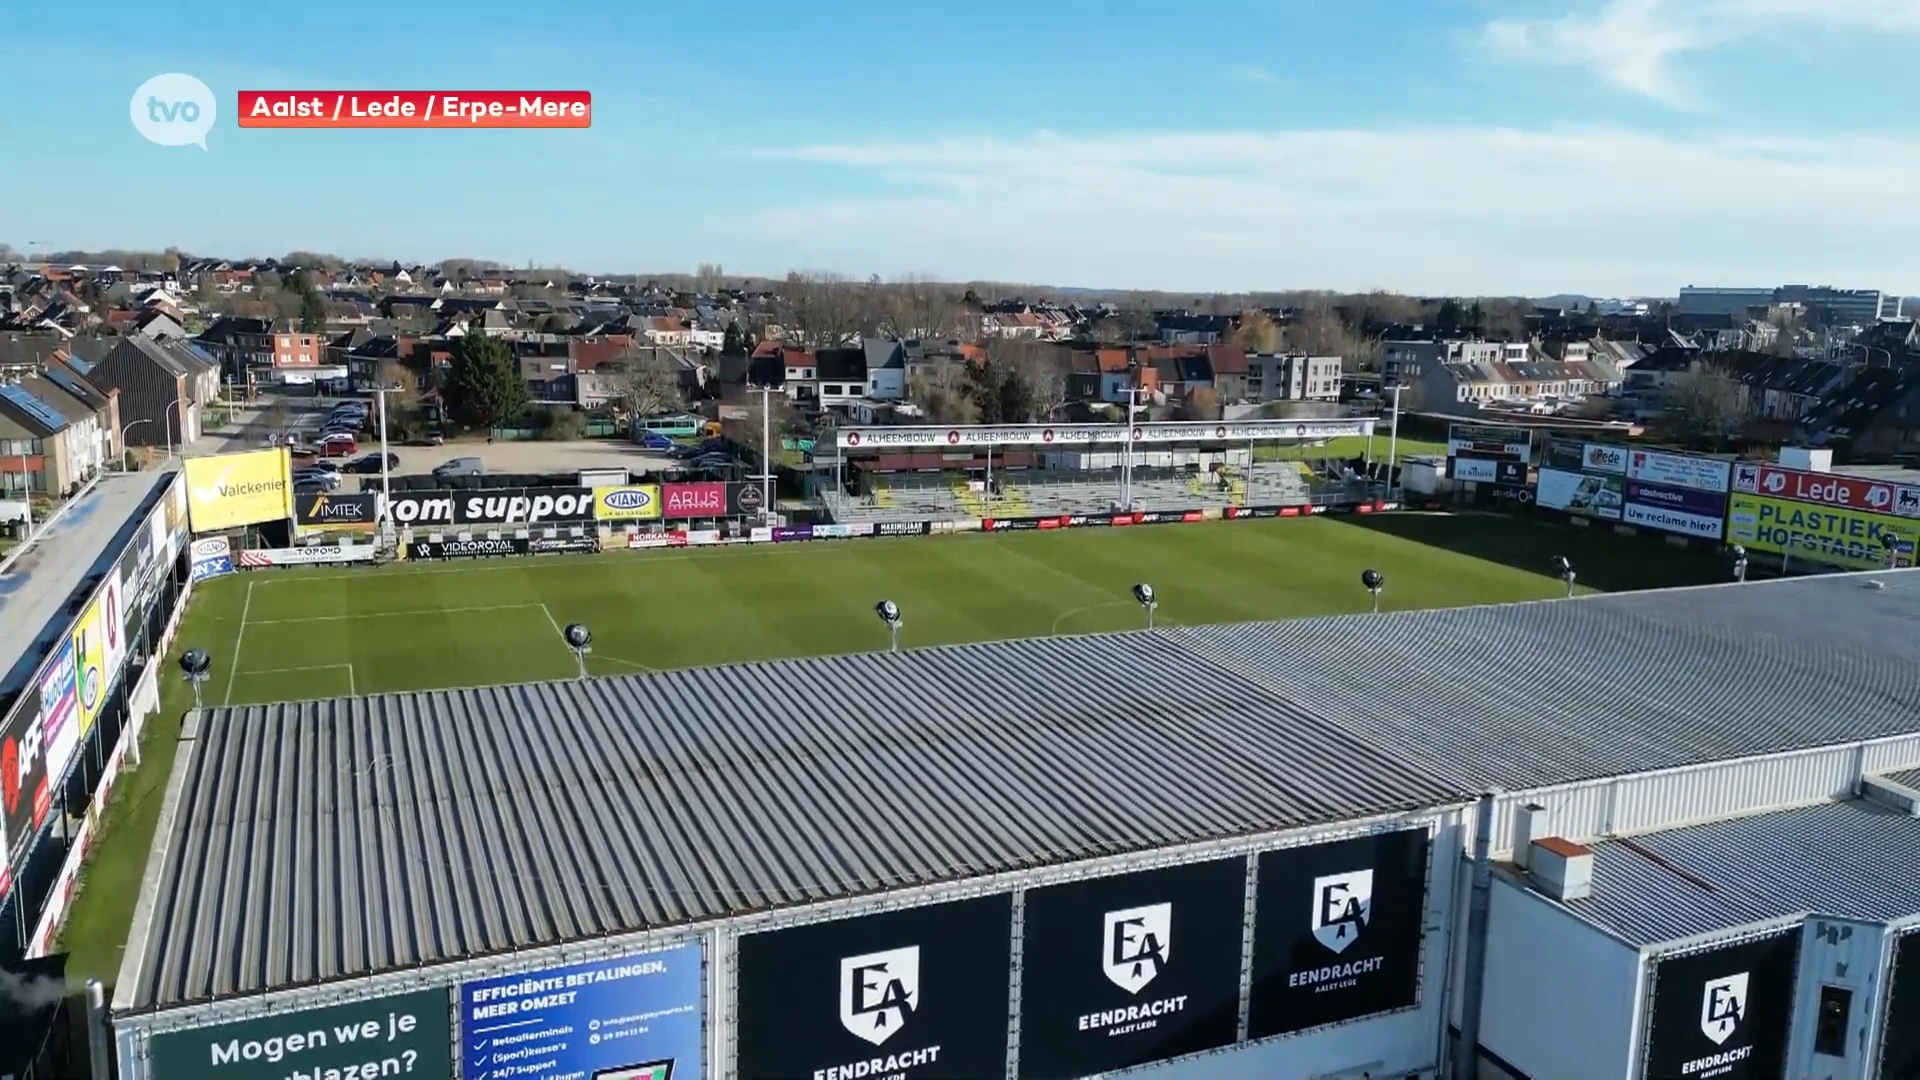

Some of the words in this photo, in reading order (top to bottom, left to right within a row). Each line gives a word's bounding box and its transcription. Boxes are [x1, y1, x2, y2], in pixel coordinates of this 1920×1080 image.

[867, 433, 936, 443] ALHEEMBOUW
[966, 432, 1031, 442] ALHEEMBOUW
[1060, 430, 1121, 440] ALHEEMBOUW
[1147, 428, 1207, 438] ALHEEMBOUW
[218, 480, 287, 497] Valckenier
[1796, 476, 1850, 503] Lede
[610, 494, 645, 506] VIANO
[669, 491, 719, 505] ARIJS
[321, 503, 363, 516] IMTEK
[378, 493, 455, 522] kom
[1629, 508, 1644, 519] Uw
[1646, 513, 1687, 527] reclame
[1690, 520, 1717, 532] hier?
[1764, 504, 1889, 540] PLASTIEK
[441, 540, 514, 552] VIDEOROYAL
[633, 533, 669, 542] NORKAN
[1761, 525, 1885, 562] HOFSTADE
[1289, 956, 1384, 987] EENDRACHT
[472, 974, 564, 1003] EFFICIËNTE
[566, 961, 668, 988] BETALINGEN,
[1315, 982, 1338, 994] AALST
[1339, 979, 1356, 988] LEDE
[472, 1002, 518, 1020] MEER
[520, 991, 578, 1012] OMZET
[1079, 994, 1188, 1031] EENDRACHT
[1108, 1024, 1136, 1036] AALST
[1136, 1020, 1158, 1031] LEDE
[211, 1028, 327, 1066] Mogen
[334, 1020, 380, 1045] we
[387, 1012, 417, 1042] je
[814, 1045, 940, 1080] EENDRACHT
[1682, 1045, 1753, 1074] EENDRACHT
[492, 1066, 515, 1079] 24/7
